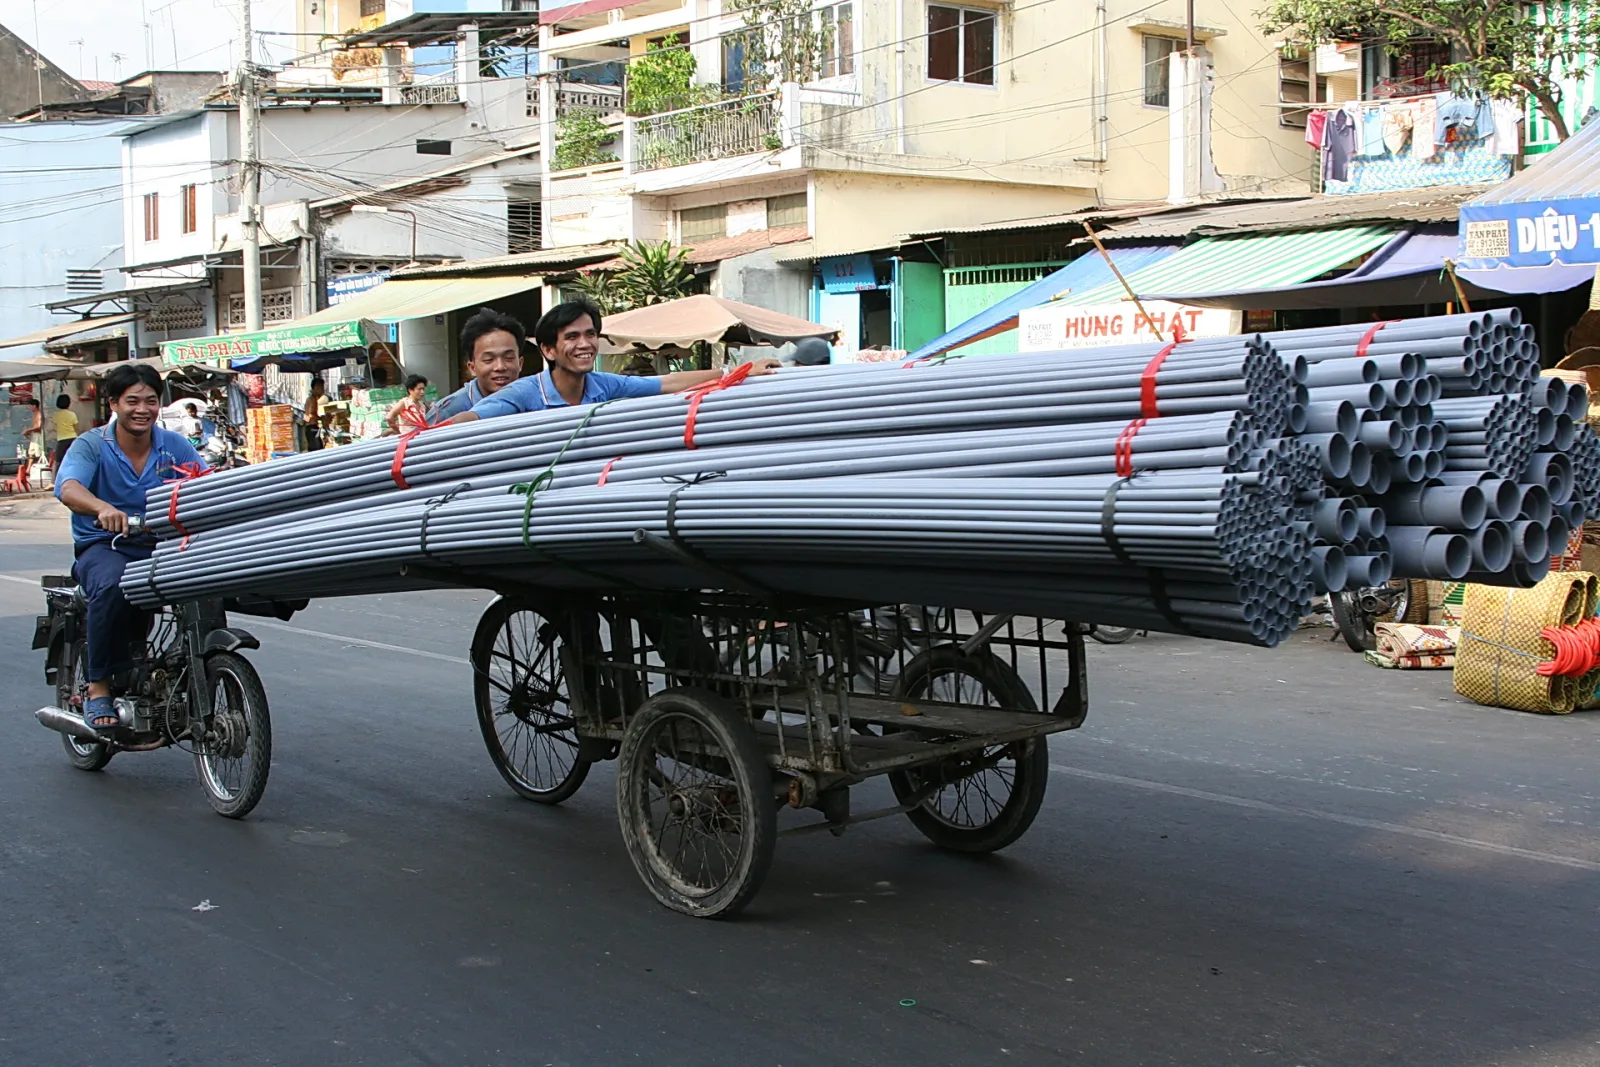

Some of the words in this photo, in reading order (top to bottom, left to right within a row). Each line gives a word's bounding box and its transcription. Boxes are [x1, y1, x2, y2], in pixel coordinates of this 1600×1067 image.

[1065, 310, 1123, 338] HÙNG
[1133, 304, 1203, 335] PHÁT
[176, 341, 206, 360] TÀI
[206, 336, 253, 357] PHÁT
